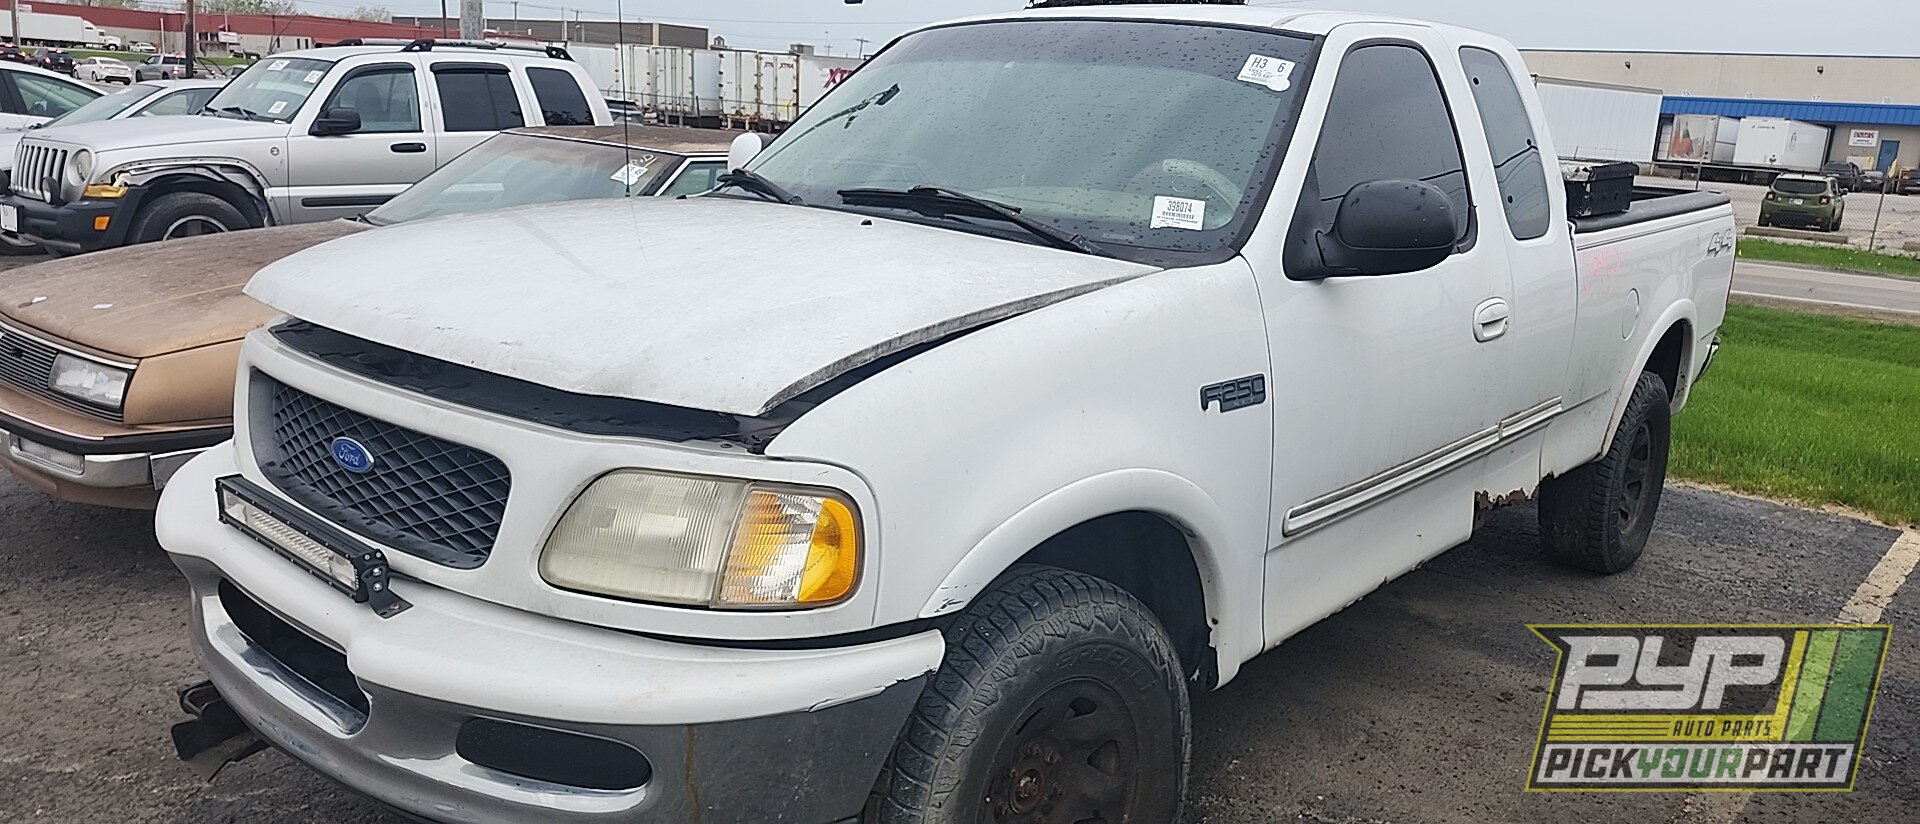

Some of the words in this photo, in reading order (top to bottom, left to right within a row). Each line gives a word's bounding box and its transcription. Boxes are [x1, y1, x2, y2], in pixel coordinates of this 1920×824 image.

[1251, 57, 1268, 69] H3
[1277, 62, 1287, 73] 6
[1167, 200, 1193, 213] 398074
[1201, 375, 1265, 412] F250
[338, 442, 361, 466] Ford
